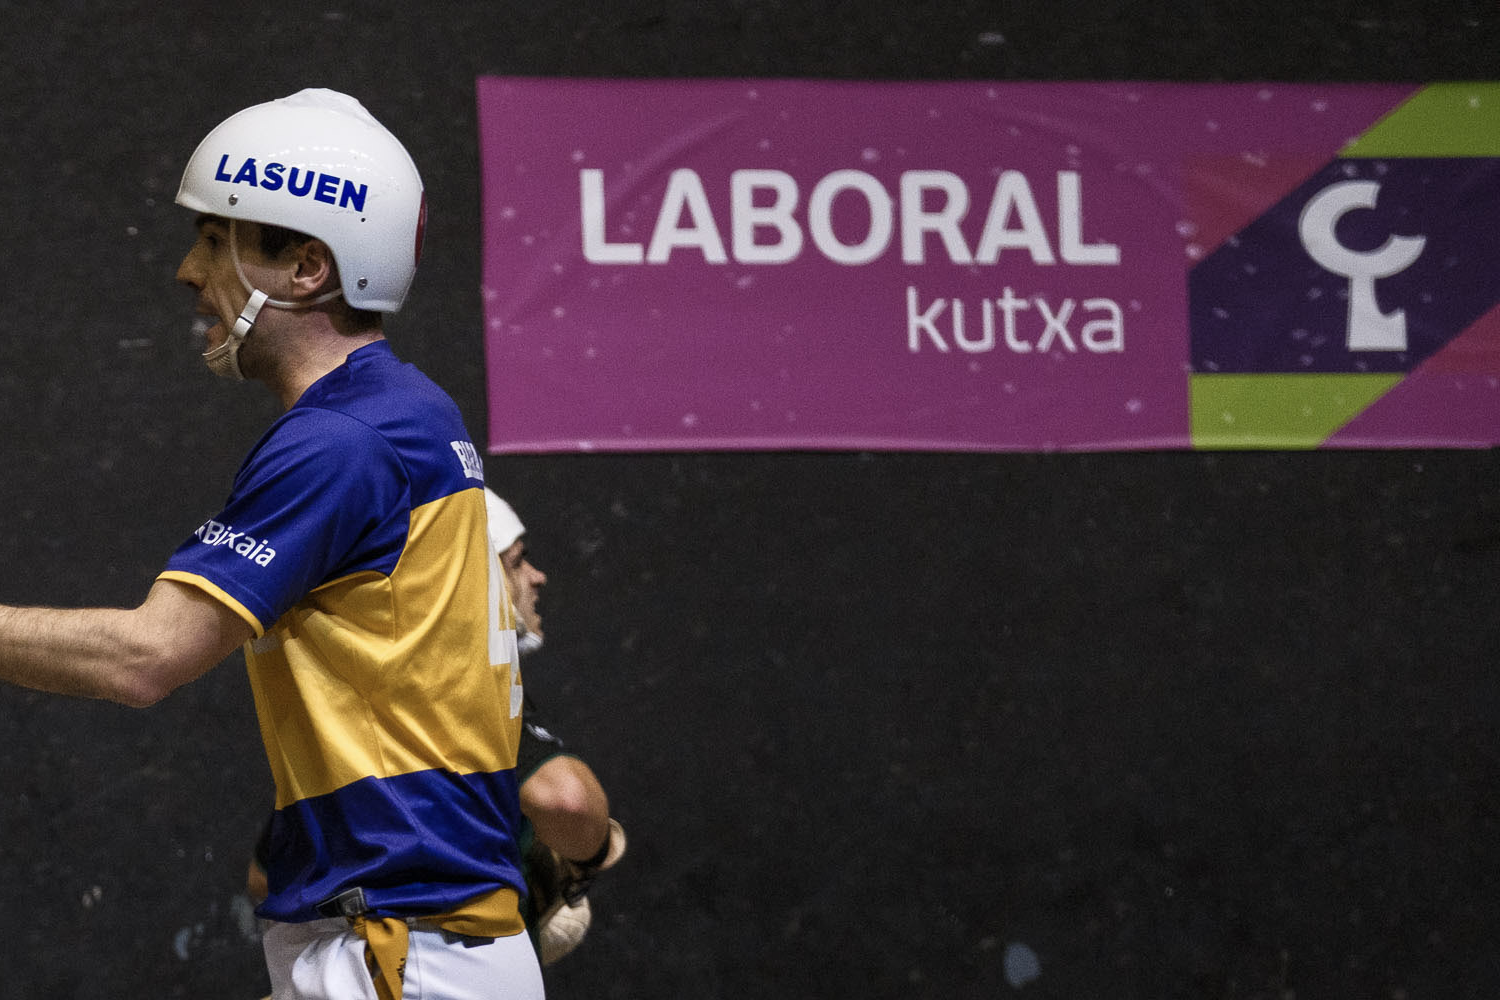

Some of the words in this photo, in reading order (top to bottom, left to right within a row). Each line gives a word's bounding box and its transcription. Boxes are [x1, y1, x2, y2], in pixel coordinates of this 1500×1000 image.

[214, 154, 368, 213] LASUEN
[580, 168, 1121, 265] LABORAL
[907, 286, 1124, 353] kutxa
